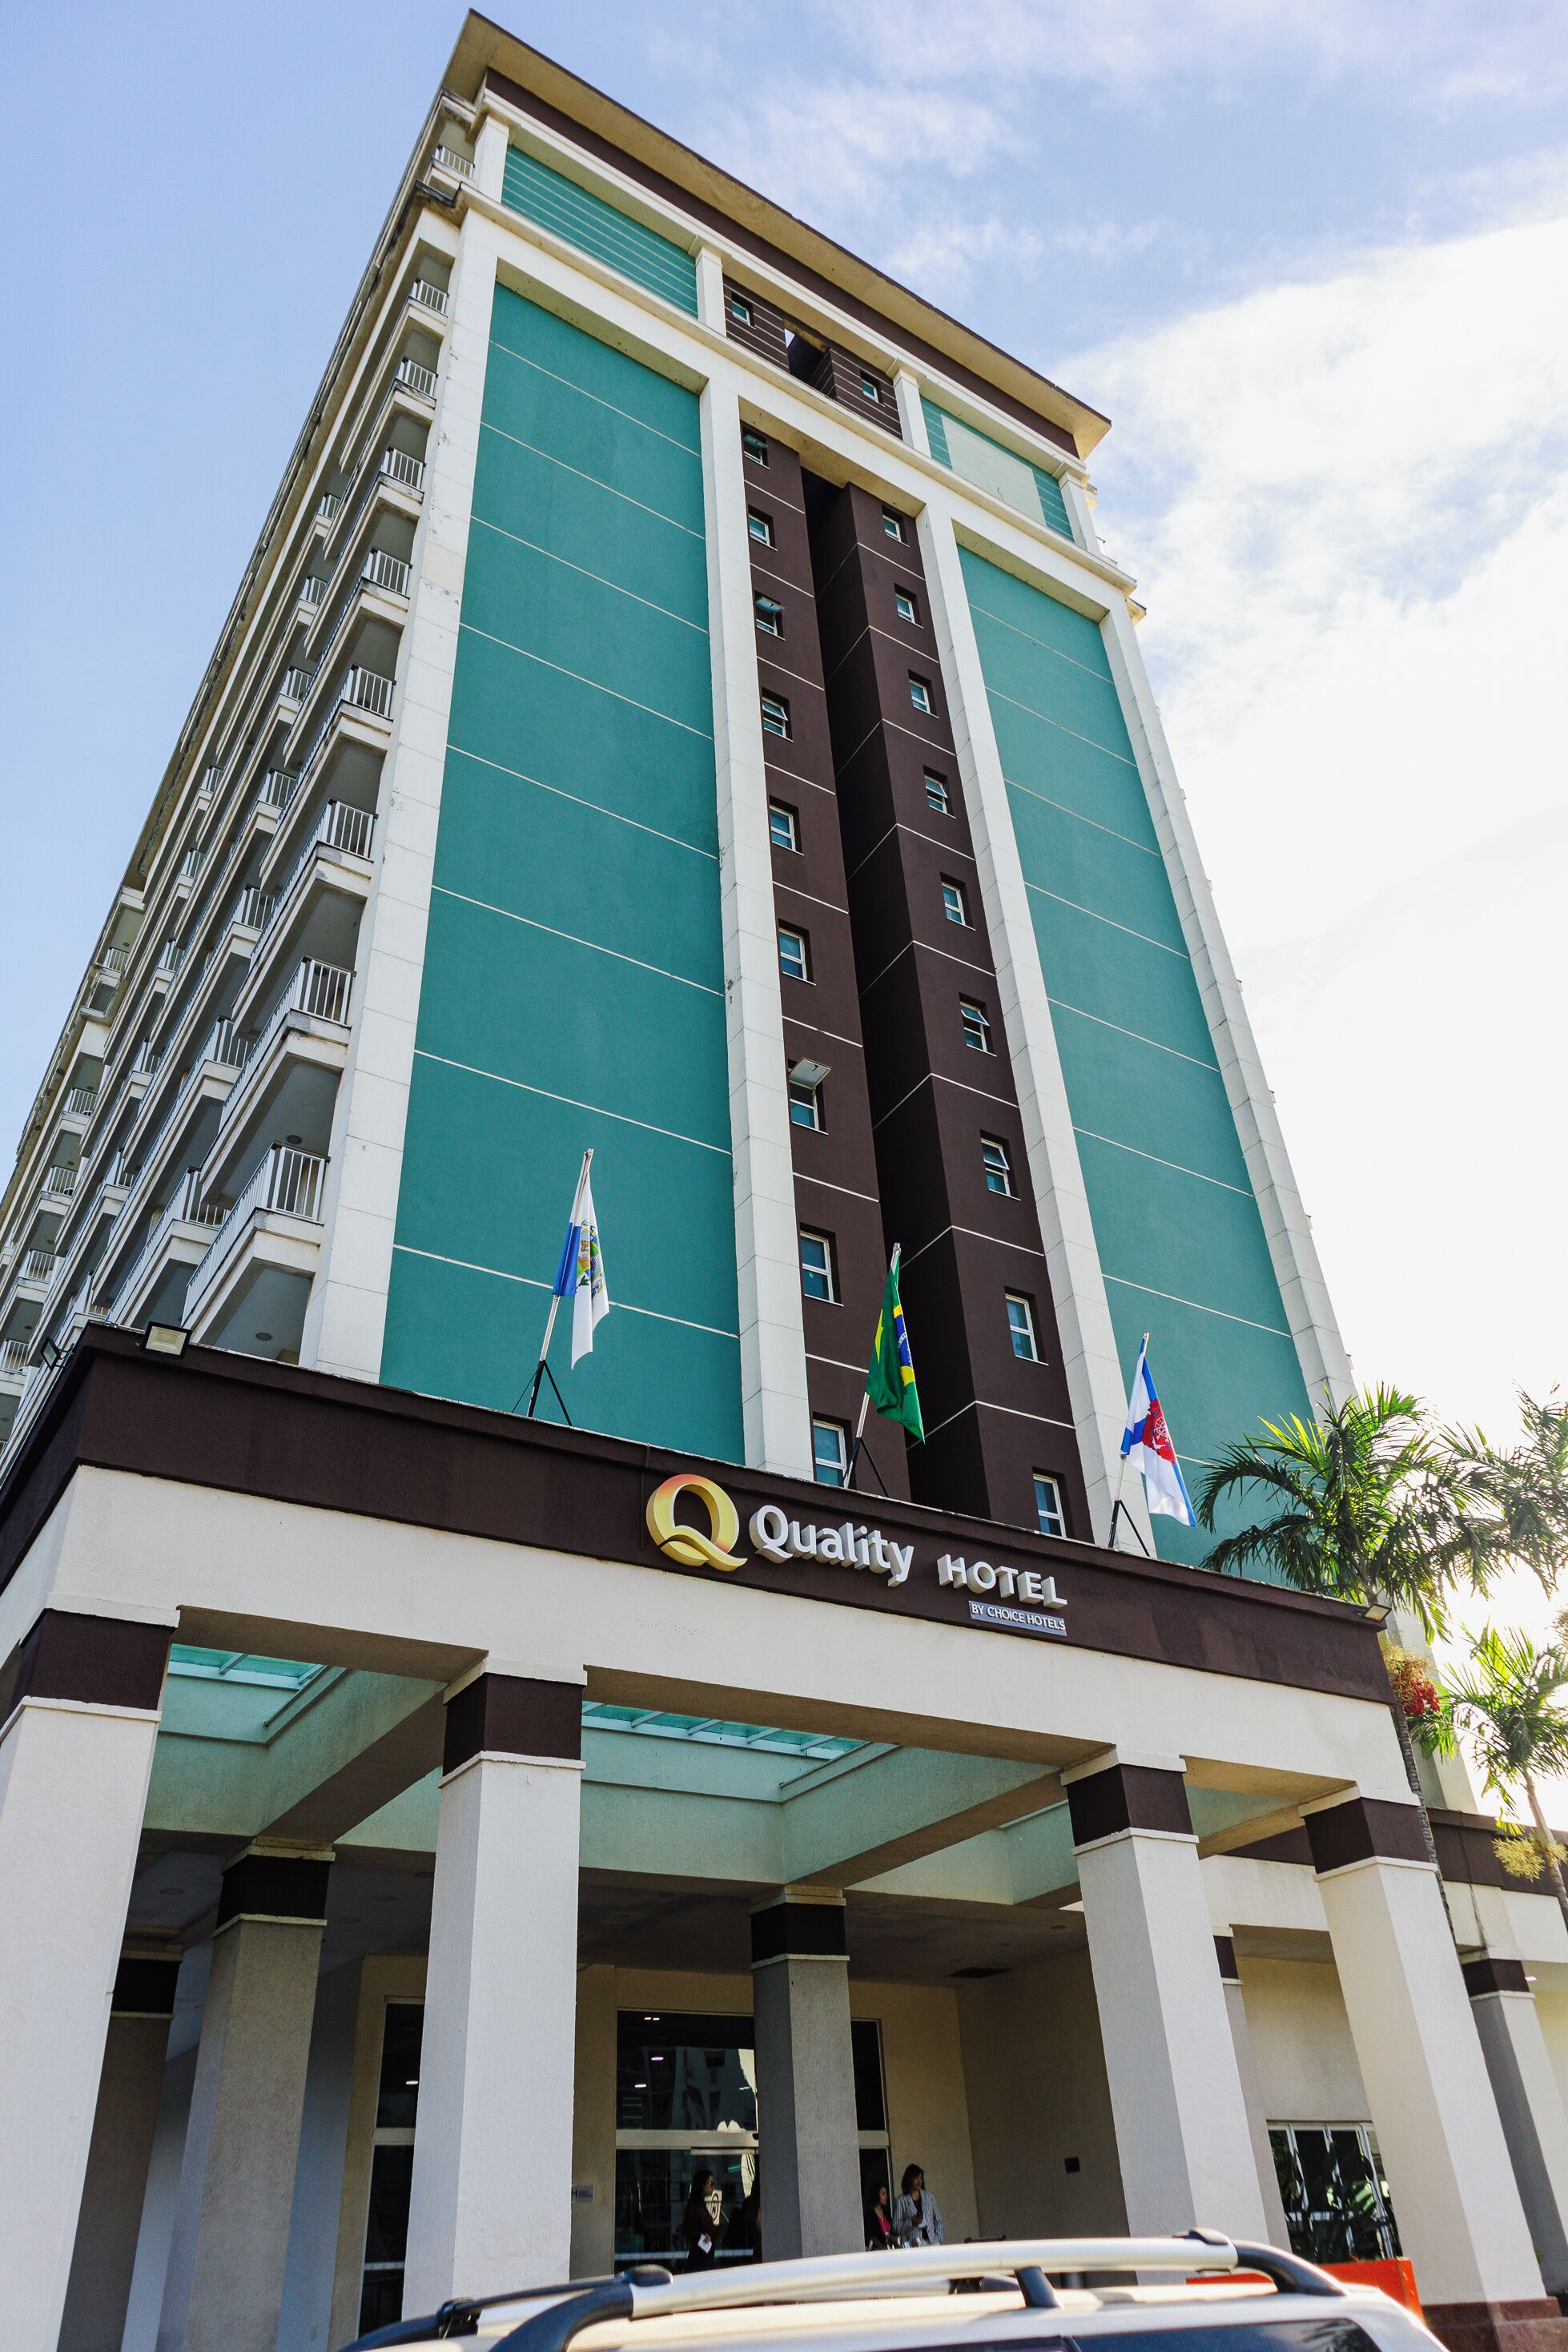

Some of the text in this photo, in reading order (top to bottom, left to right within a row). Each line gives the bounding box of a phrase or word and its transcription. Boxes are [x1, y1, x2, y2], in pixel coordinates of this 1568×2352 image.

[646, 1474, 748, 1572] Q
[749, 1505, 1068, 1610] Quality HOTEL
[971, 1603, 1066, 1631] BY CHOICE HOTELS
